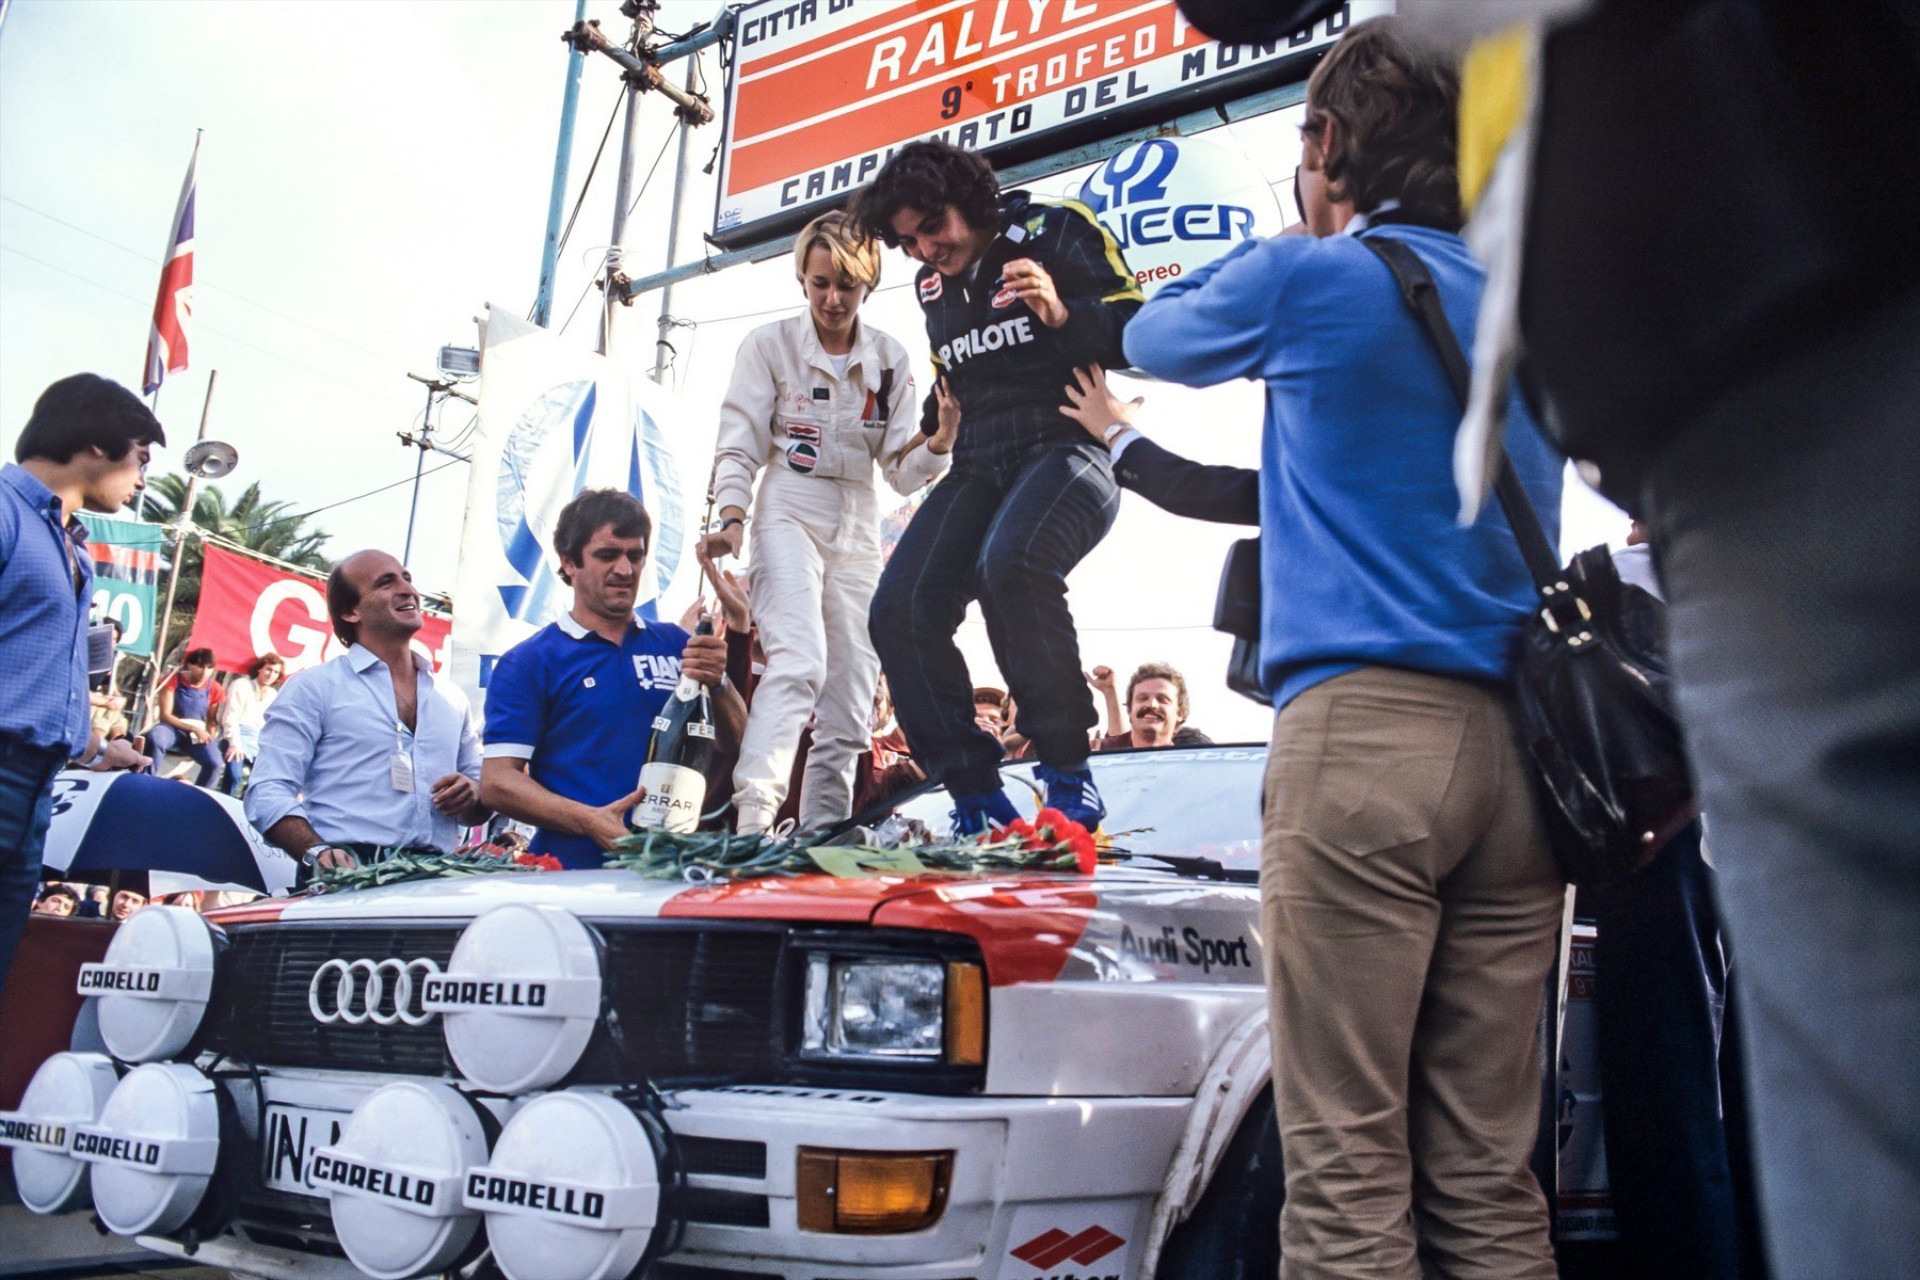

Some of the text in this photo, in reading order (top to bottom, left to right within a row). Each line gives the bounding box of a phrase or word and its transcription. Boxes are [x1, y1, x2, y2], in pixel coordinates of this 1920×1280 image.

[992, 23, 1157, 105] TROFEO
[1064, 70, 1149, 118] DEL
[1098, 203, 1256, 251] NEER
[1134, 262, 1182, 285] ereo
[951, 315, 1035, 364] PILOTE
[1121, 923, 1252, 974] Audi Sport
[80, 970, 160, 992] CARELLO
[425, 981, 546, 1007] CARELLO
[0, 1119, 66, 1147] CARELLO
[73, 1132, 160, 1166] CARELLO
[312, 1155, 436, 1207] CARELLO
[467, 1173, 605, 1219] CARELLO
